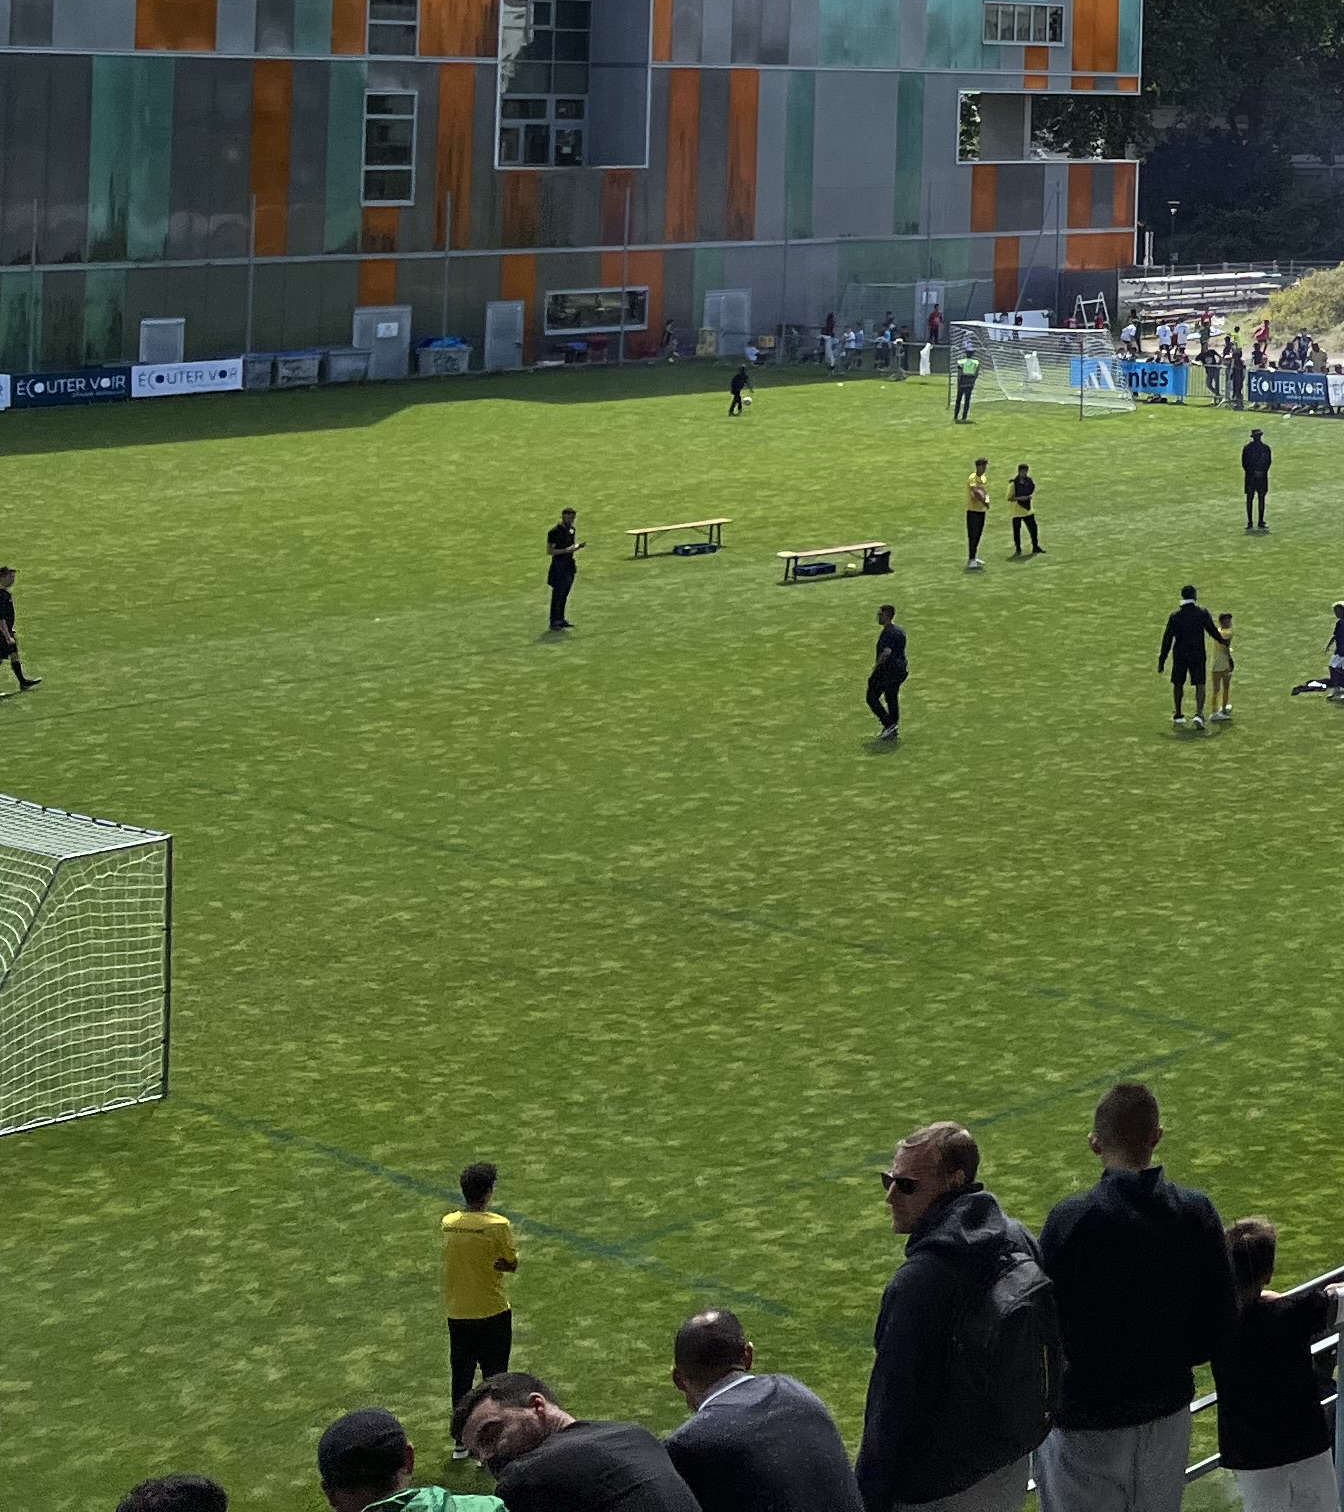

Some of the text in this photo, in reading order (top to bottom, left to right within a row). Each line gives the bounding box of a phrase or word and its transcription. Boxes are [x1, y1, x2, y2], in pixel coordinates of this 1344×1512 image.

[16, 378, 86, 398] ÉCOUTER
[89, 375, 126, 390] VOIR
[1250, 376, 1325, 396] ÉCOUTER VOIR
